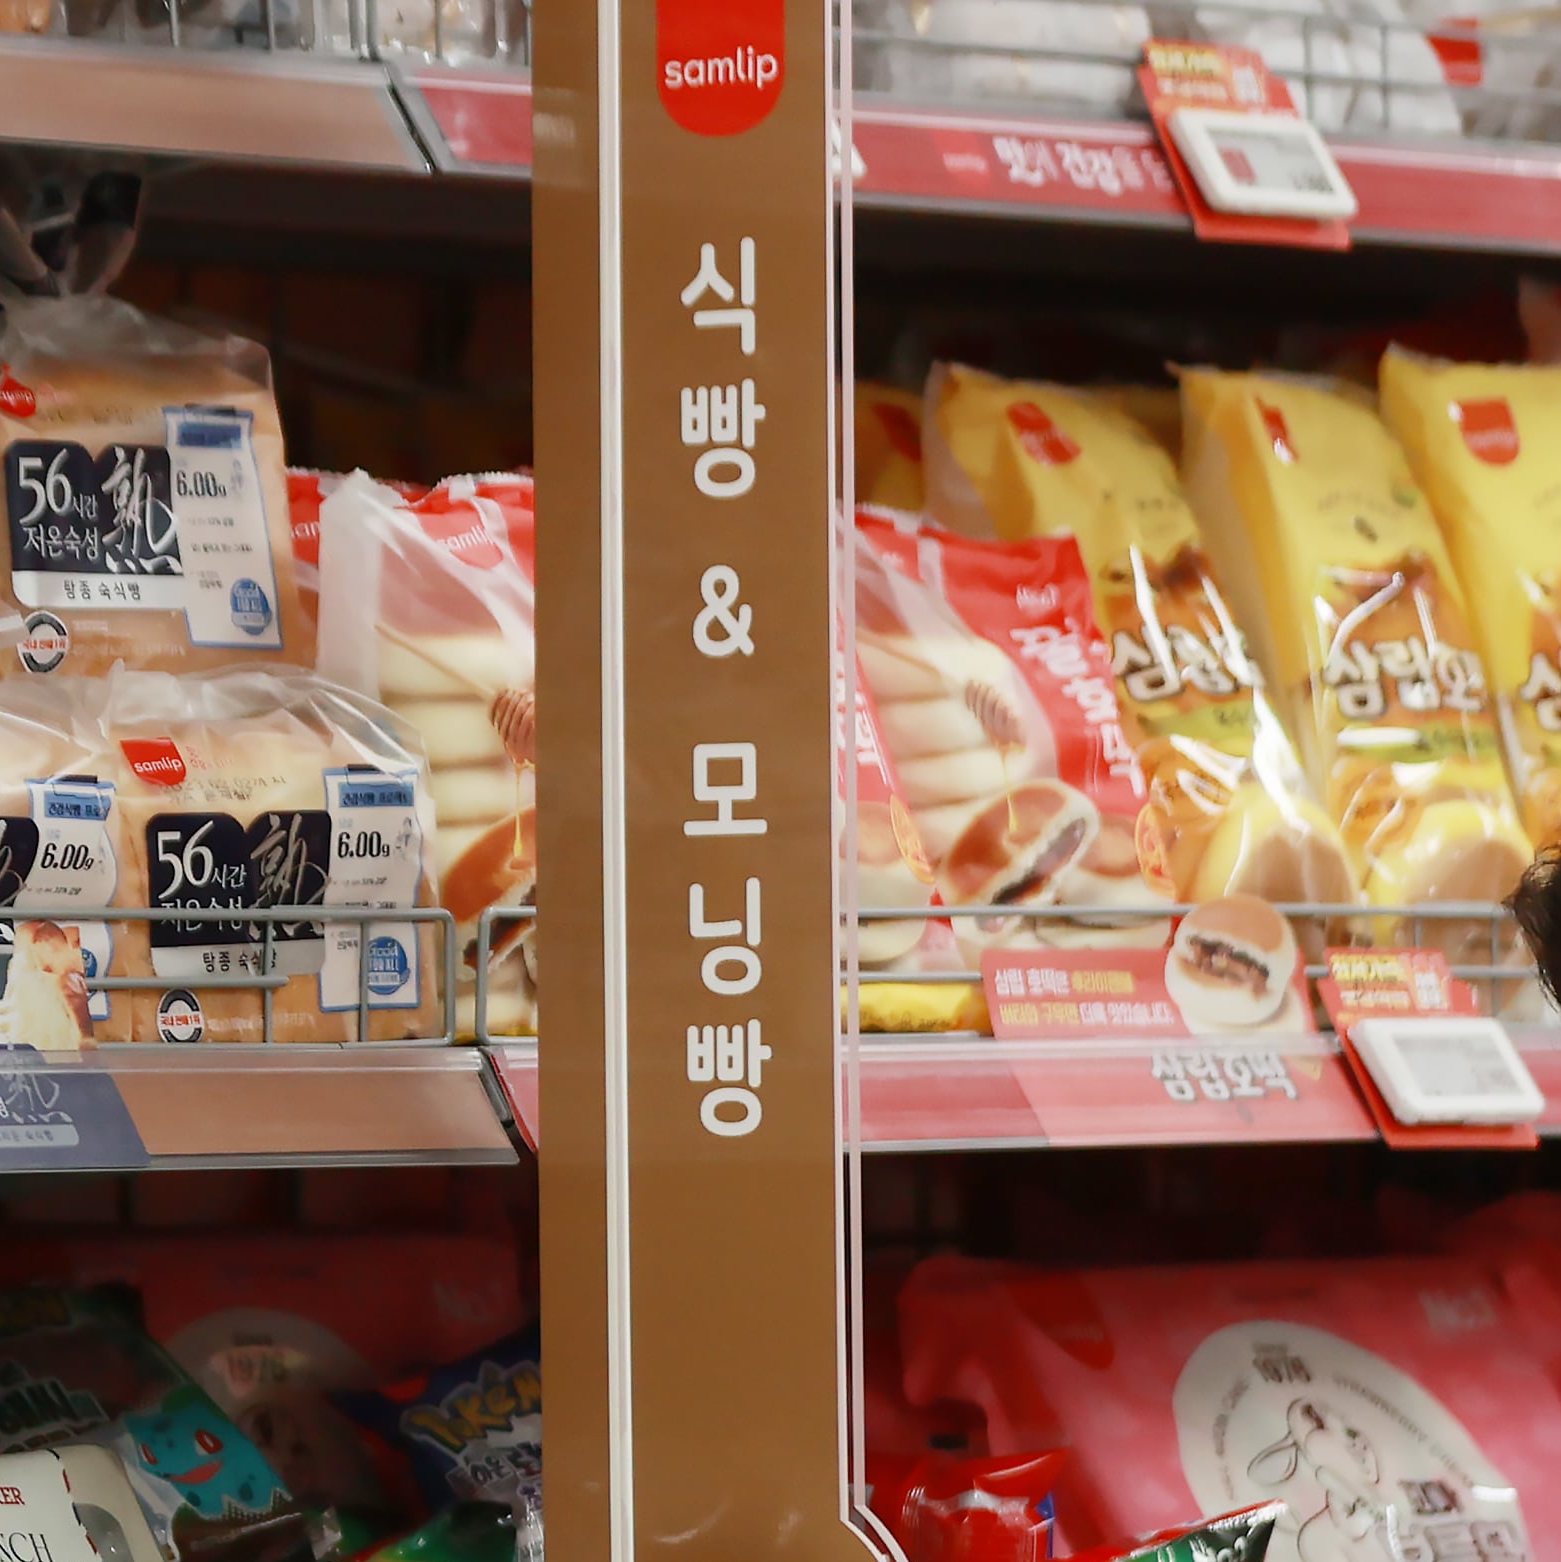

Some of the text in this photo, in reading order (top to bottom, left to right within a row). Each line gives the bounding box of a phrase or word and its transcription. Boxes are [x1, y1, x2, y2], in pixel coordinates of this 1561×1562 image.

[664, 45, 778, 91] samlip
[18, 447, 99, 527] 56 시간
[176, 469, 227, 499] 6.00g
[23, 525, 99, 562] 저온숙성
[680, 235, 772, 1137] 식빵 & 모닝빵
[134, 757, 183, 774] samlip
[40, 842, 95, 871] 6.00g
[156, 819, 247, 900] 56 시간
[337, 830, 390, 859] 6.00g
[201, 951, 231, 973] 탕종
